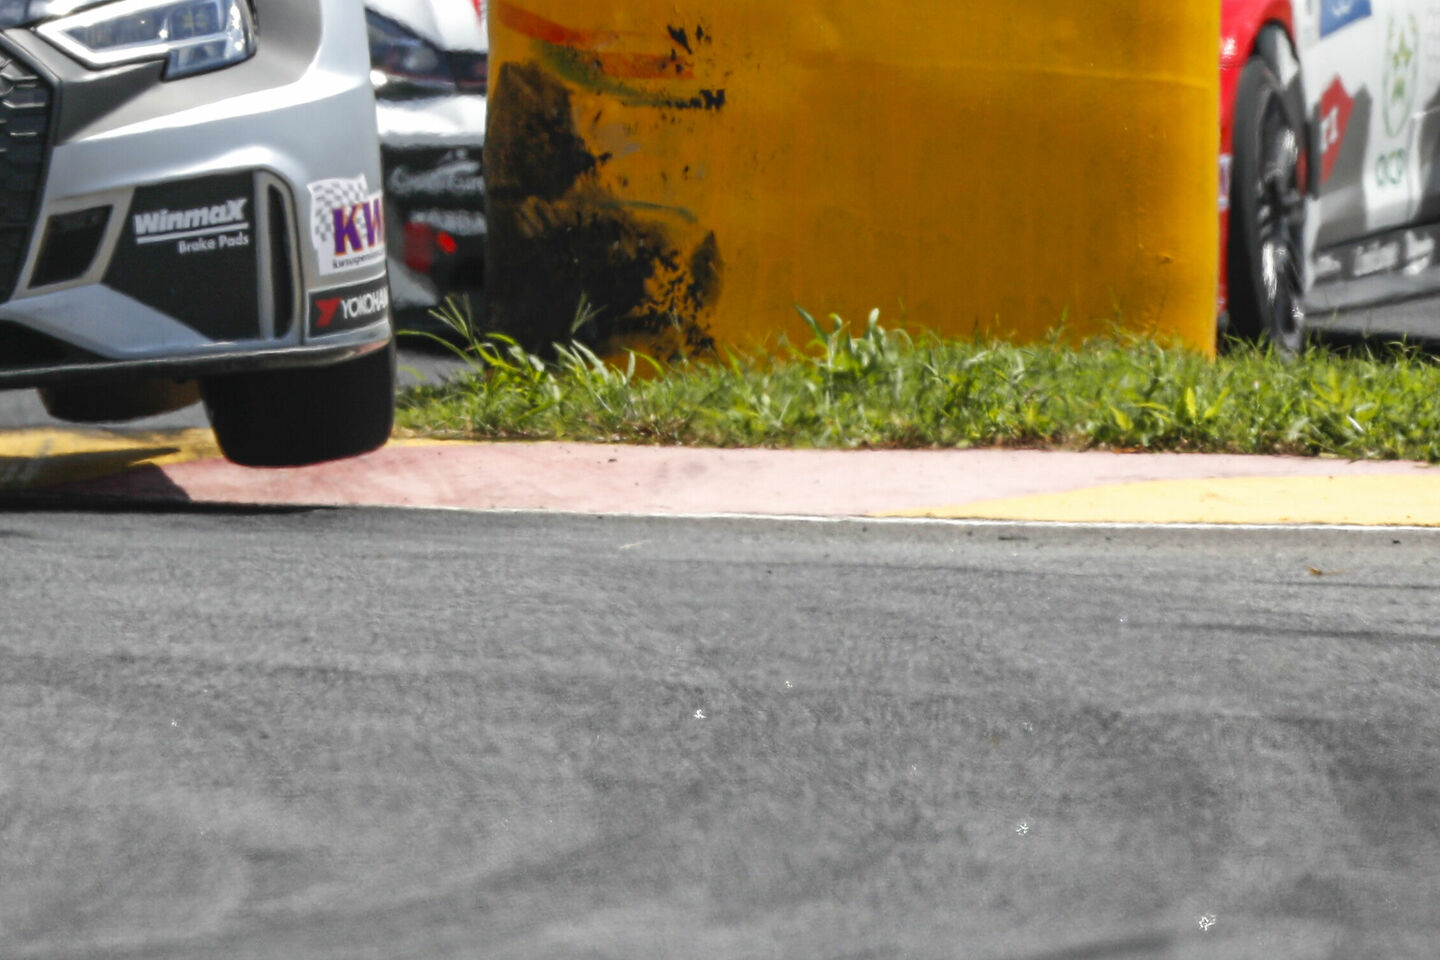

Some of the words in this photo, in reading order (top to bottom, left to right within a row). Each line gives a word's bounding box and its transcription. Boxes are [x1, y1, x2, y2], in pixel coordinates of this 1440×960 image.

[178, 237, 215, 254] Brake
[218, 231, 249, 248] Pads
[332, 198, 385, 257] KW
